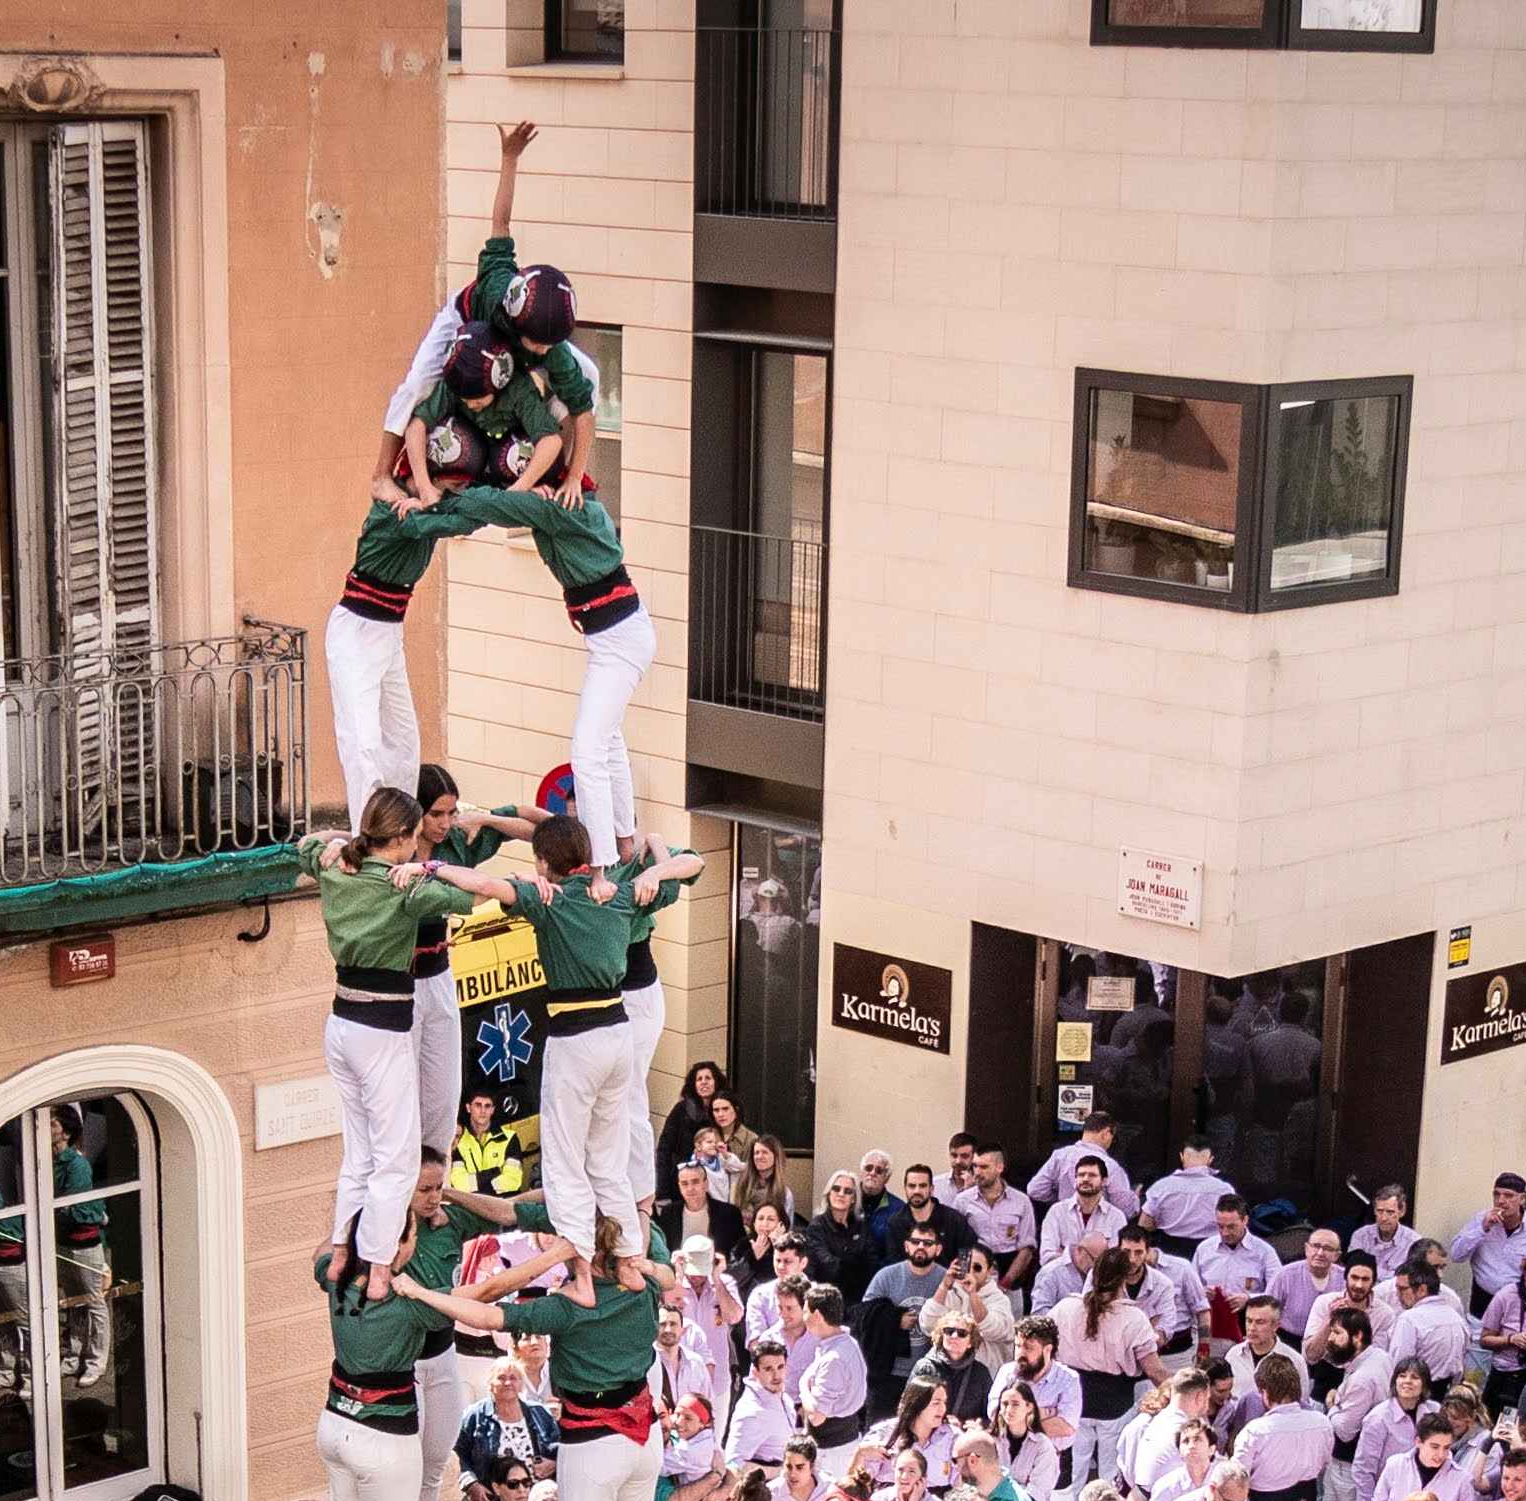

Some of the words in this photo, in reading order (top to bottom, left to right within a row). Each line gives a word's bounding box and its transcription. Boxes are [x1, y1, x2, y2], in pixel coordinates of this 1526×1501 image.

[1146, 859, 1171, 872] CARRER
[1126, 878, 1145, 892] JOAN
[1149, 883, 1189, 902] MARAGALL
[841, 993, 941, 1037] Karmela's
